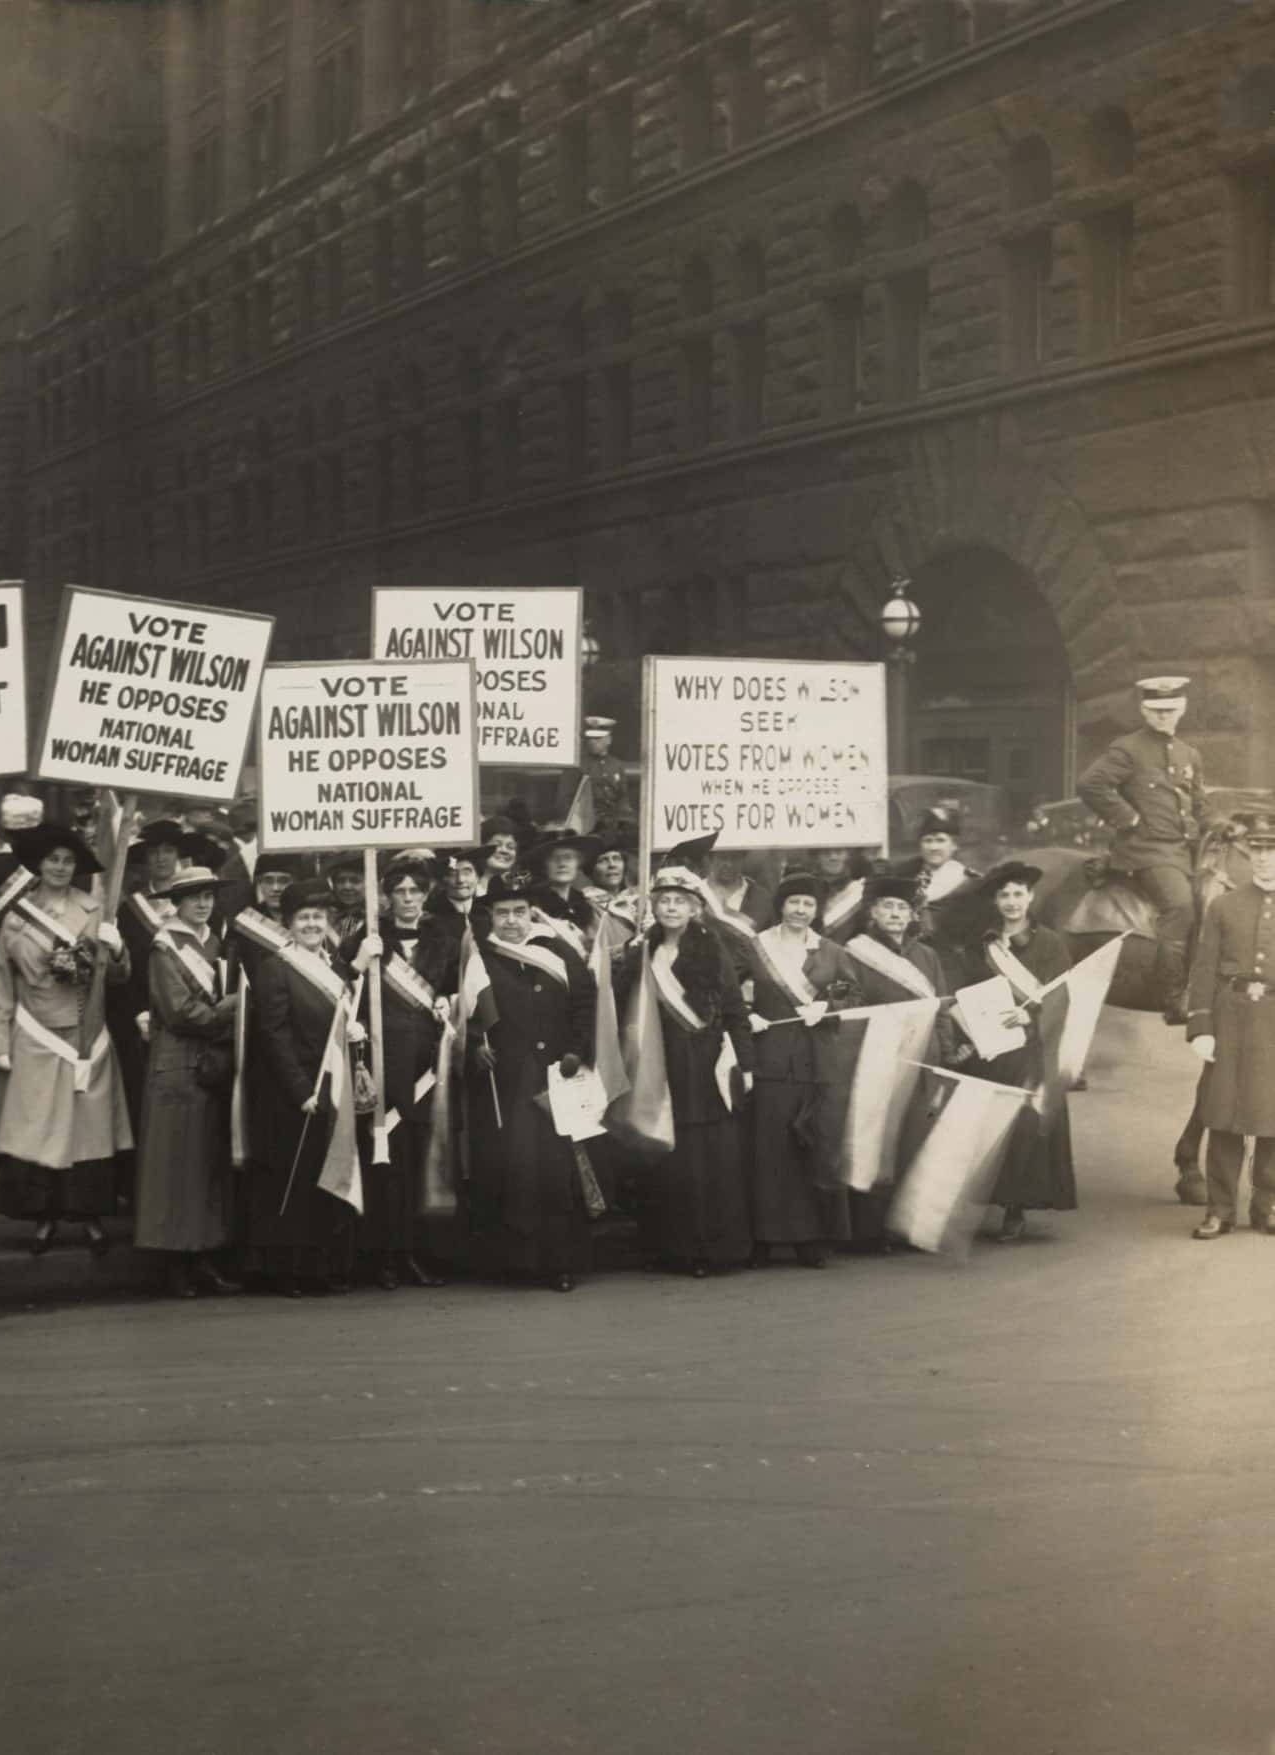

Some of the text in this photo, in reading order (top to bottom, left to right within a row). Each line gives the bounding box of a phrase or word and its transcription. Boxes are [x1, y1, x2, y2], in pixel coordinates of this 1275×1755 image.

[433, 602, 515, 623] VOTE
[128, 612, 207, 645] VOTE
[385, 627, 563, 661] AGAINST WILSON
[69, 633, 251, 692] AGAINST WILSON
[320, 675, 408, 698] VOTE
[674, 675, 723, 701] WHY
[733, 676, 786, 702] DOES
[79, 680, 228, 723] HE OPPOSES
[99, 718, 195, 751] NATIONAL
[268, 701, 461, 740] AGAINST WILSON
[51, 738, 228, 783] WOMAN SUFFRAGE
[288, 746, 447, 772] HE OPPOSES
[665, 743, 729, 772] VOTES
[740, 743, 792, 771] FROM
[317, 781, 423, 804] NATIONAL
[701, 779, 743, 795] WHEN
[271, 805, 462, 833] WOMAN SUFFRAGE
[664, 803, 725, 832] VOTES
[737, 803, 775, 830] FOR
